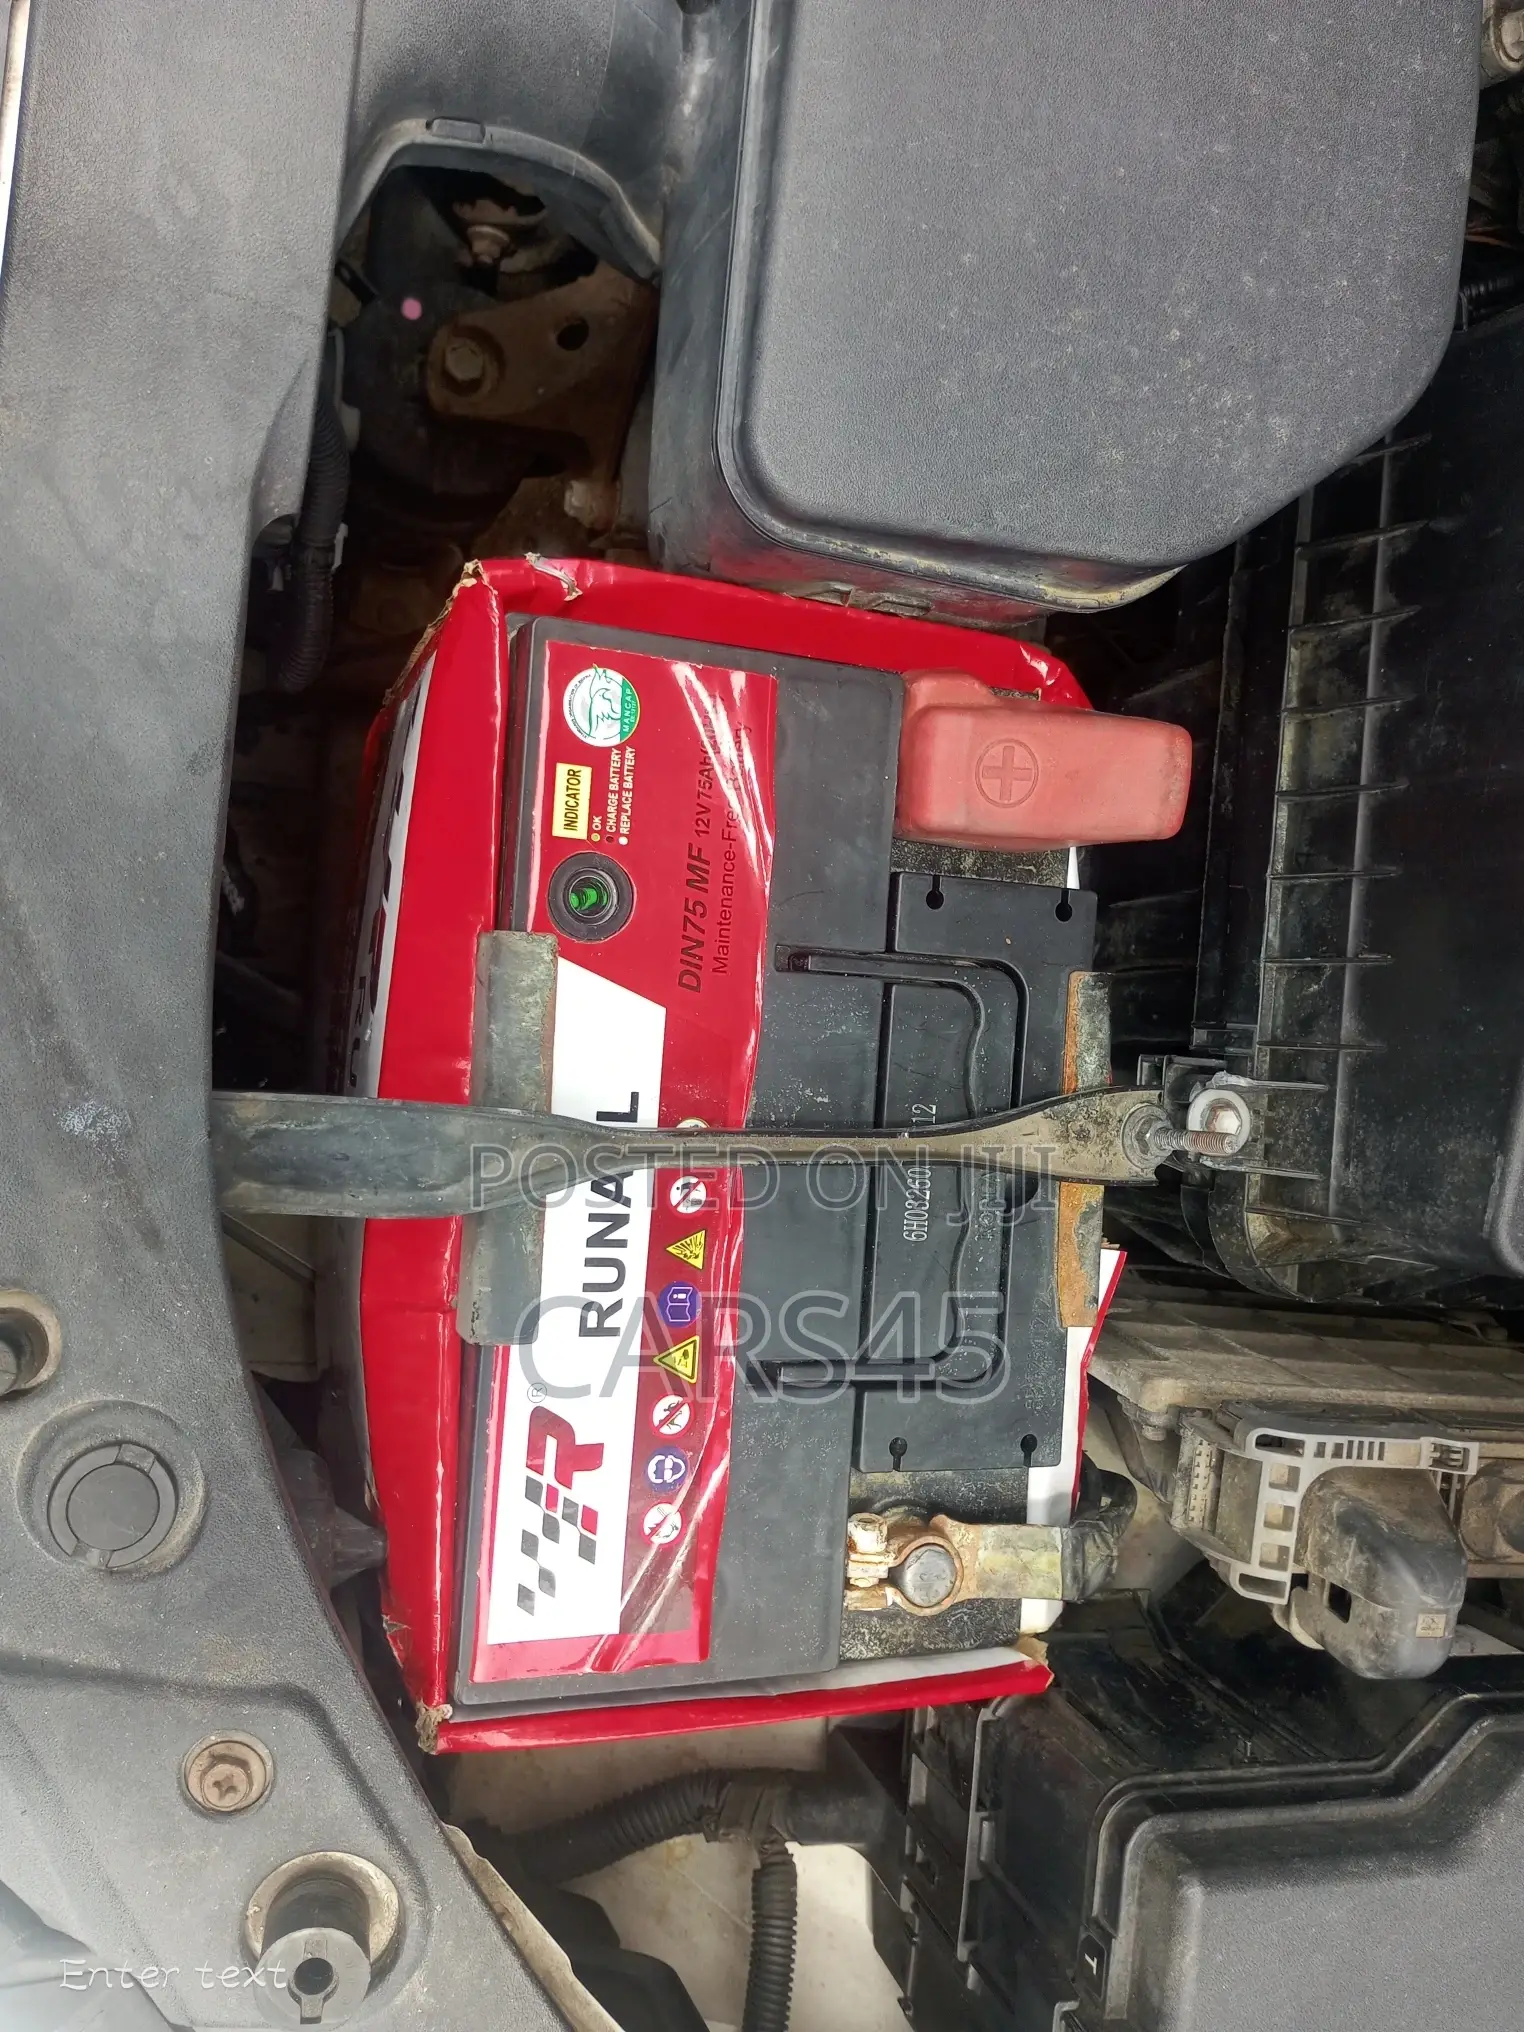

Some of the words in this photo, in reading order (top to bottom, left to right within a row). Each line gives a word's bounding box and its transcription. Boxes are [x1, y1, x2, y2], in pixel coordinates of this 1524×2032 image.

[622, 688, 632, 732] MANCAP
[608, 748, 622, 791] BATTERY
[622, 746, 636, 794] BATTERY
[563, 768, 582, 832] INDICATOR
[592, 815, 602, 831] OK
[605, 792, 618, 833] CHARGE
[620, 795, 633, 834] REPLACE
[686, 842, 712, 893] MF
[679, 897, 710, 994] DIN75
[578, 1091, 640, 1338] RUNAL
